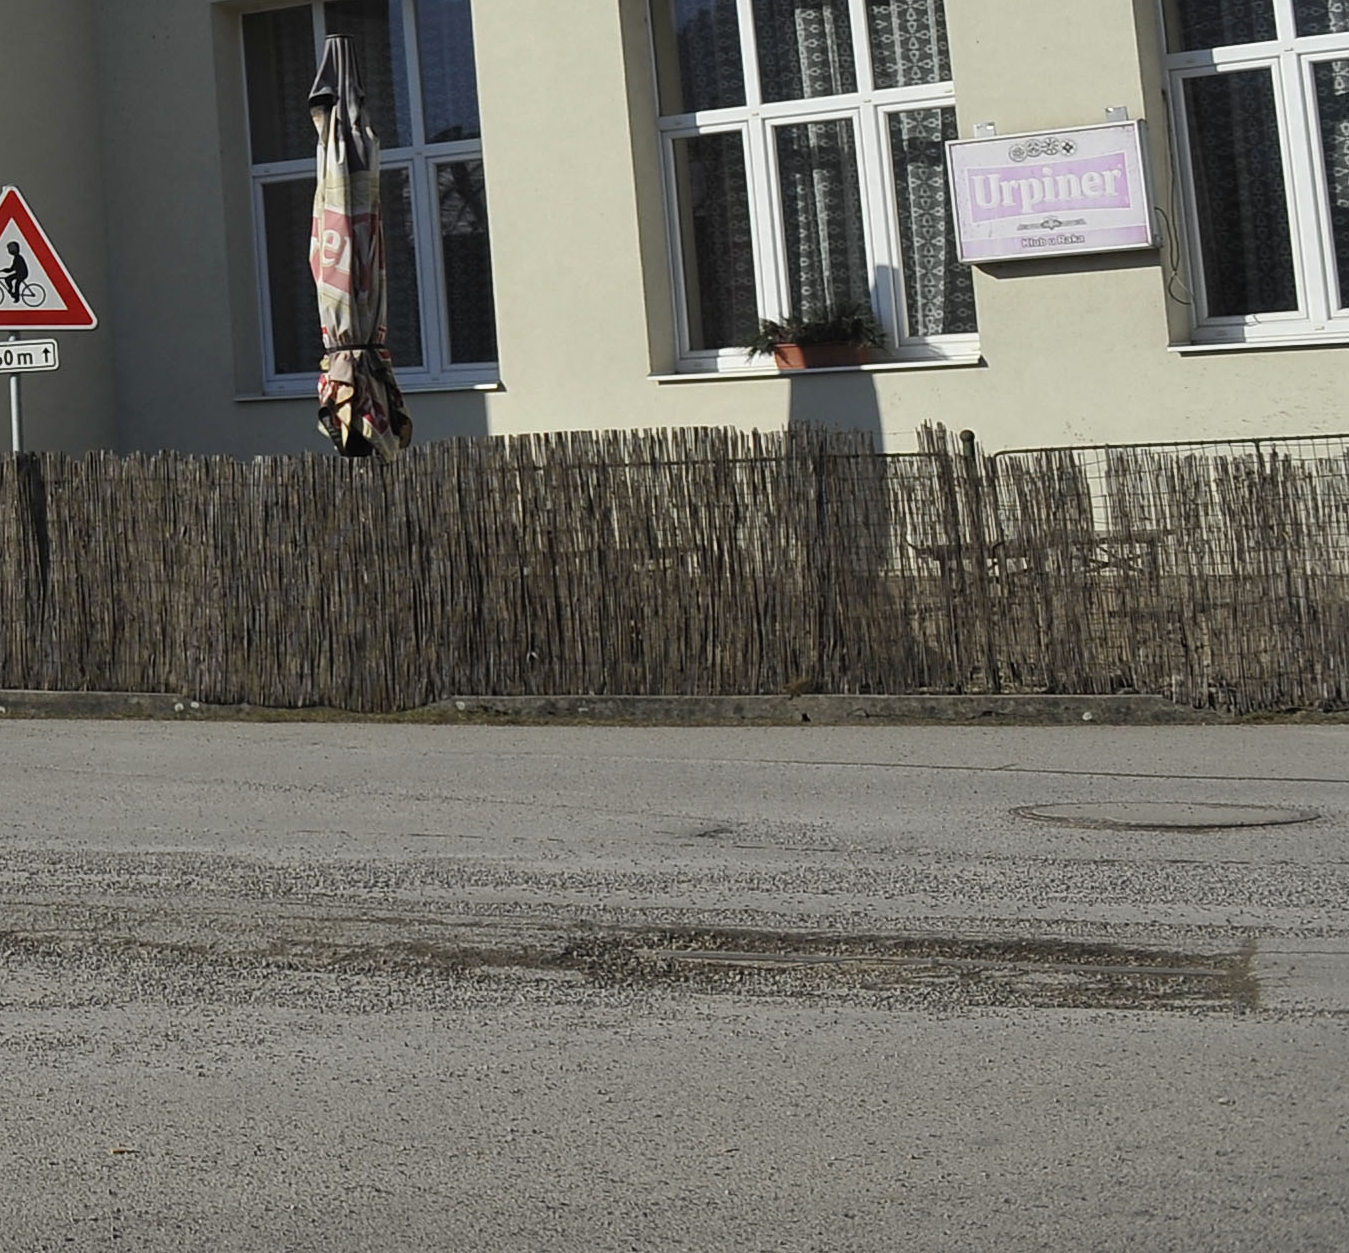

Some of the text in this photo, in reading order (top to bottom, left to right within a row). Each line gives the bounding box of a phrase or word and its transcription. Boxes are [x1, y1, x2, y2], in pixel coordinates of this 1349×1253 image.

[971, 166, 1122, 213] Urpiner
[1021, 236, 1047, 248] Klub
[17, 351, 33, 365] m
